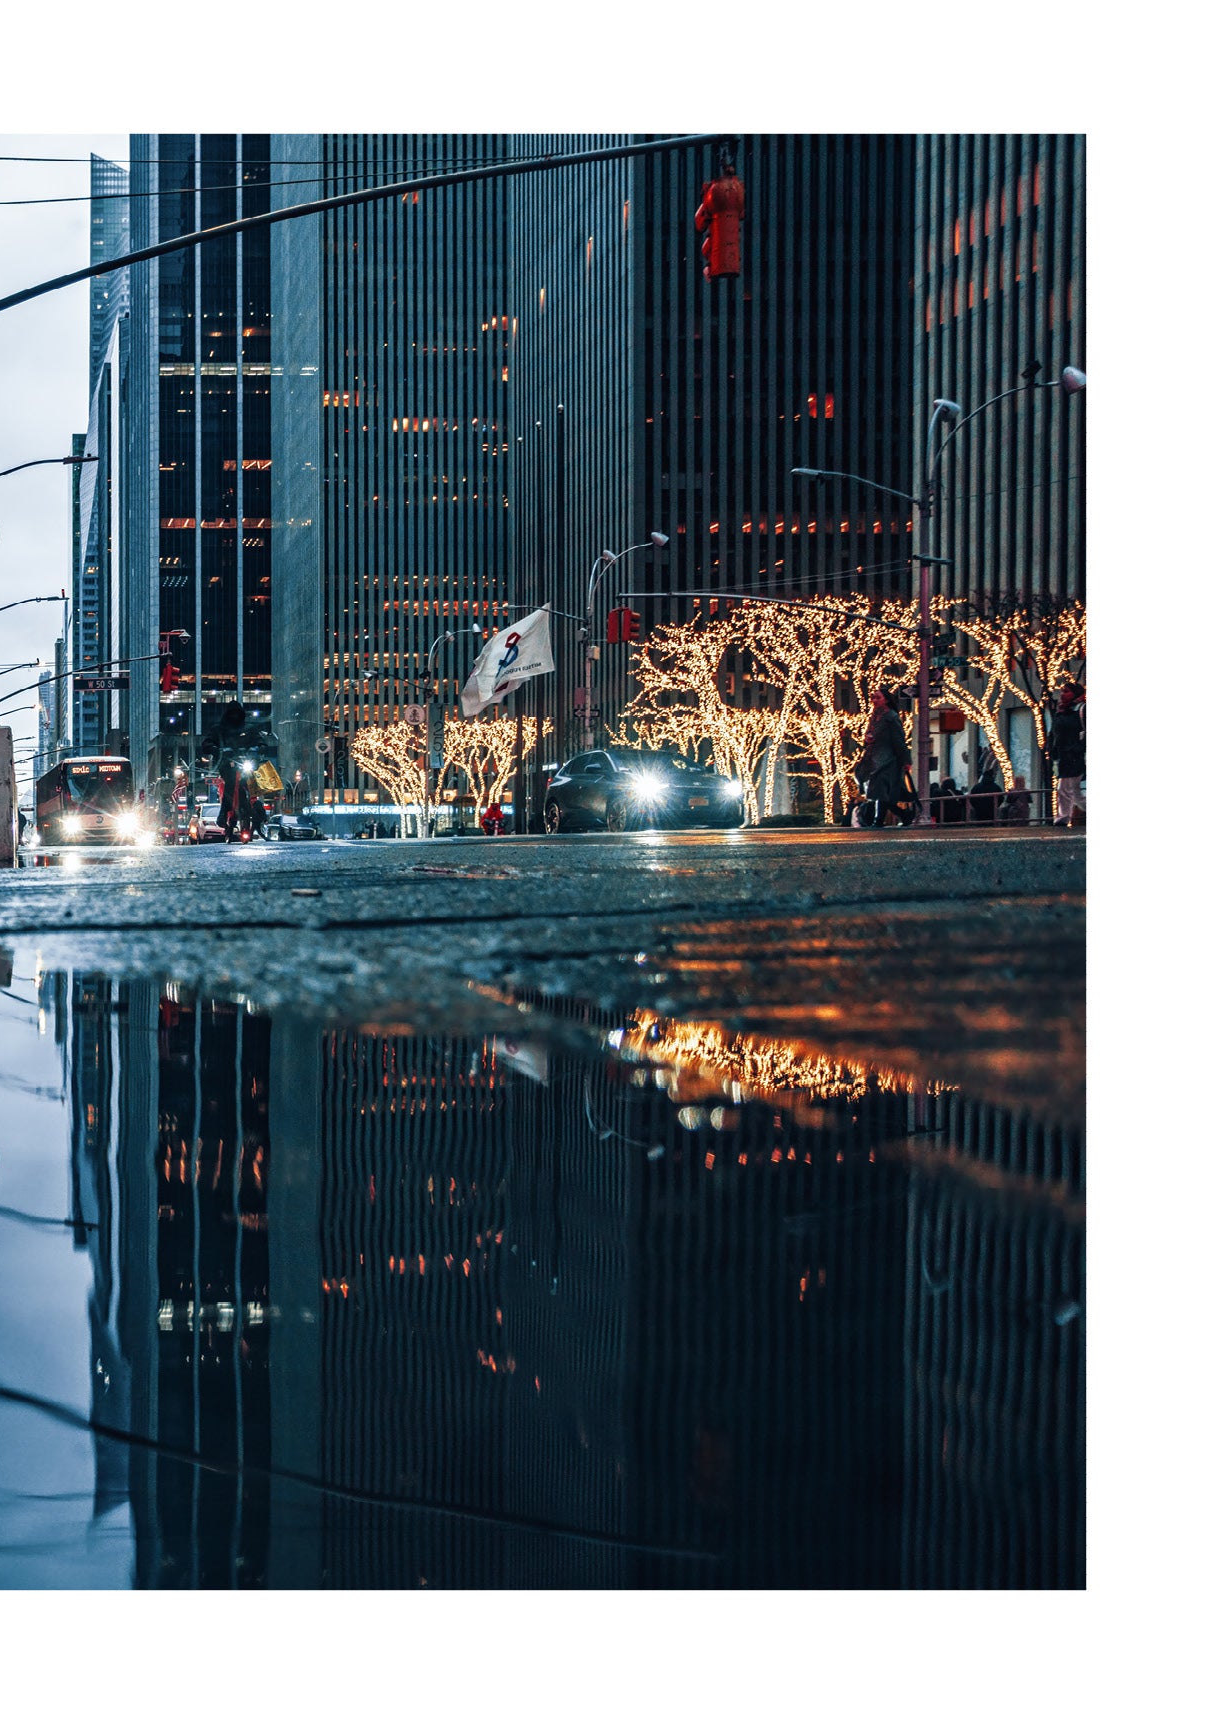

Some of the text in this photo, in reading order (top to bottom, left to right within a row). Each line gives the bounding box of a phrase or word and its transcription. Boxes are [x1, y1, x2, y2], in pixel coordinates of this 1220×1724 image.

[88, 680, 115, 689] W 50 St
